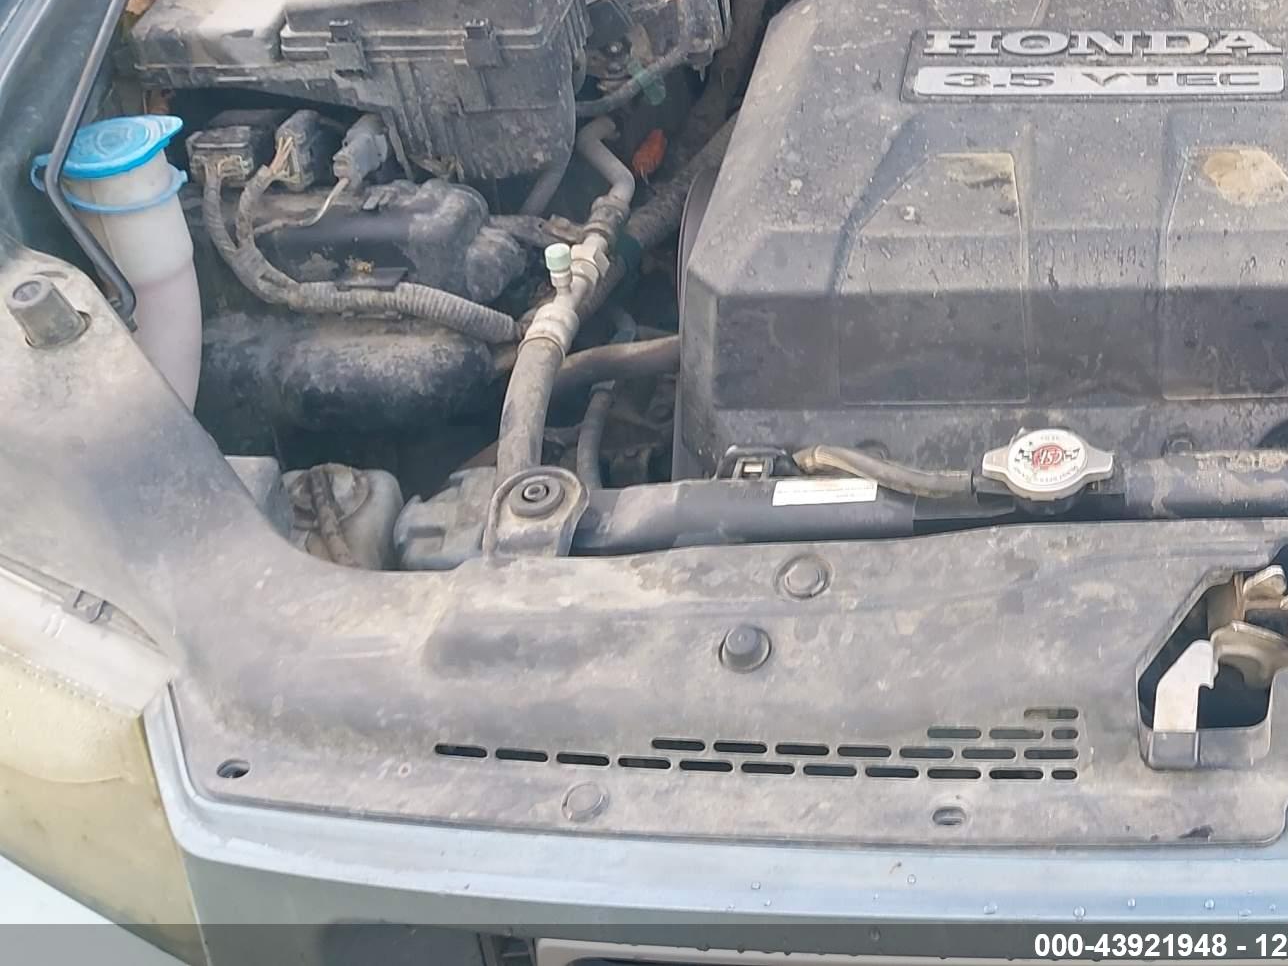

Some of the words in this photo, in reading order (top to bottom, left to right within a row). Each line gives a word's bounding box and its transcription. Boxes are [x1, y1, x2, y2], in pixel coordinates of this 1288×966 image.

[924, 30, 1283, 56] HONDA
[944, 71, 1056, 88] 3.5
[1081, 71, 1262, 88] VTEC
